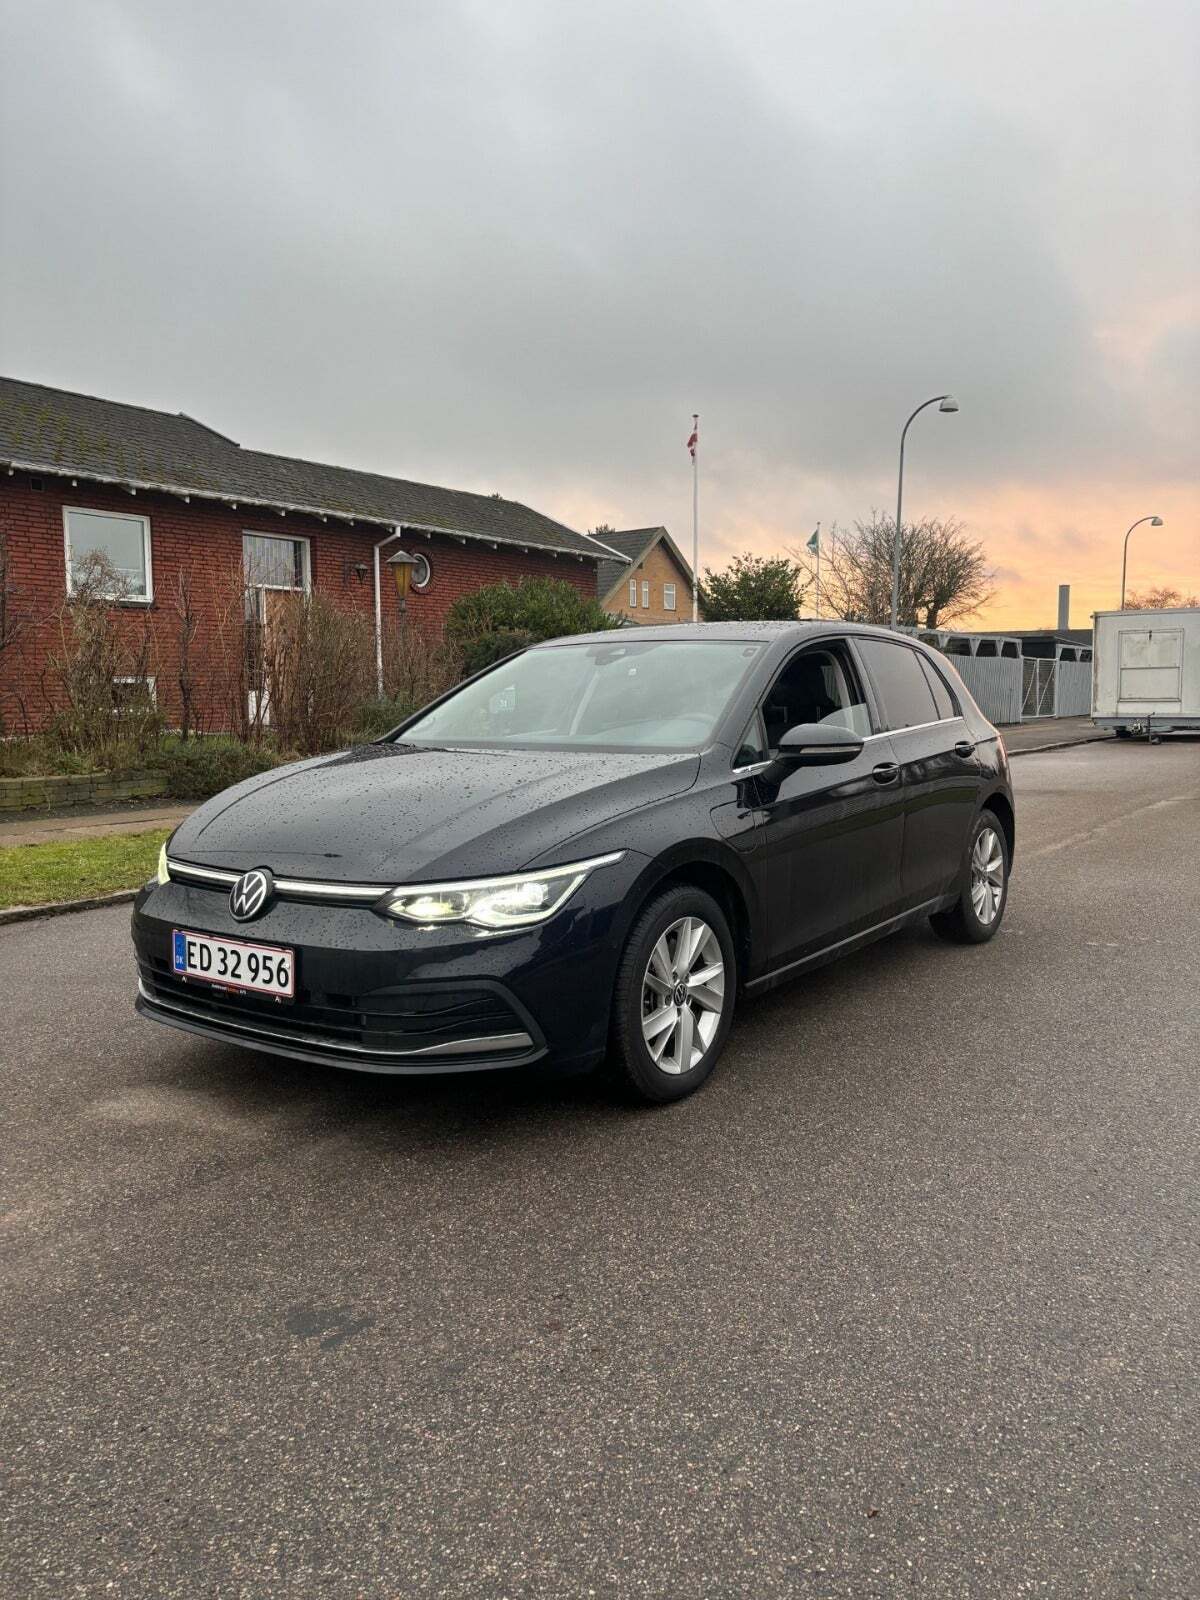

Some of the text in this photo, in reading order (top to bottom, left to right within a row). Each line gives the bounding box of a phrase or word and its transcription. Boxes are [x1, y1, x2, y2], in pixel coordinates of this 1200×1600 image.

[187, 941, 289, 988] ED 32 956
